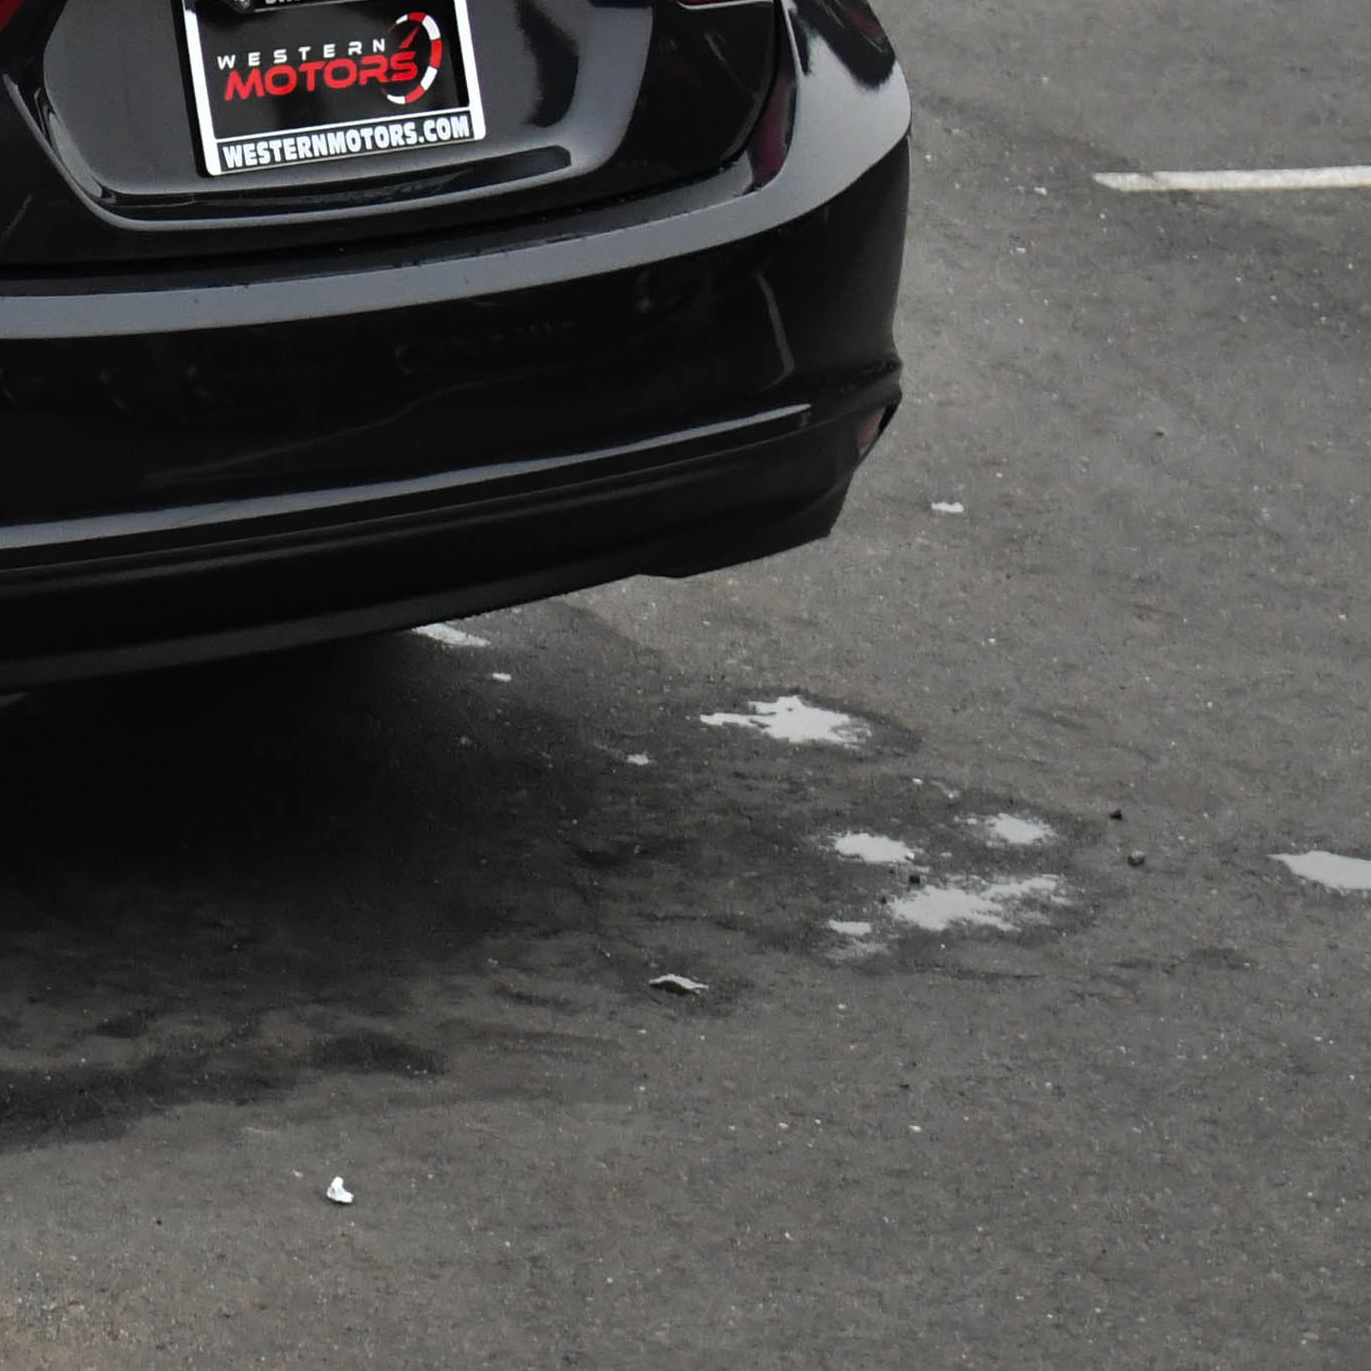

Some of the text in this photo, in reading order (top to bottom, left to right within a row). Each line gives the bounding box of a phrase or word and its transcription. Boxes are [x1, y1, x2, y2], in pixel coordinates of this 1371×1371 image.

[217, 38, 386, 69] WESTERN
[224, 51, 418, 101] MOTORS
[222, 115, 470, 168] WESTERNMOTORS.COM
